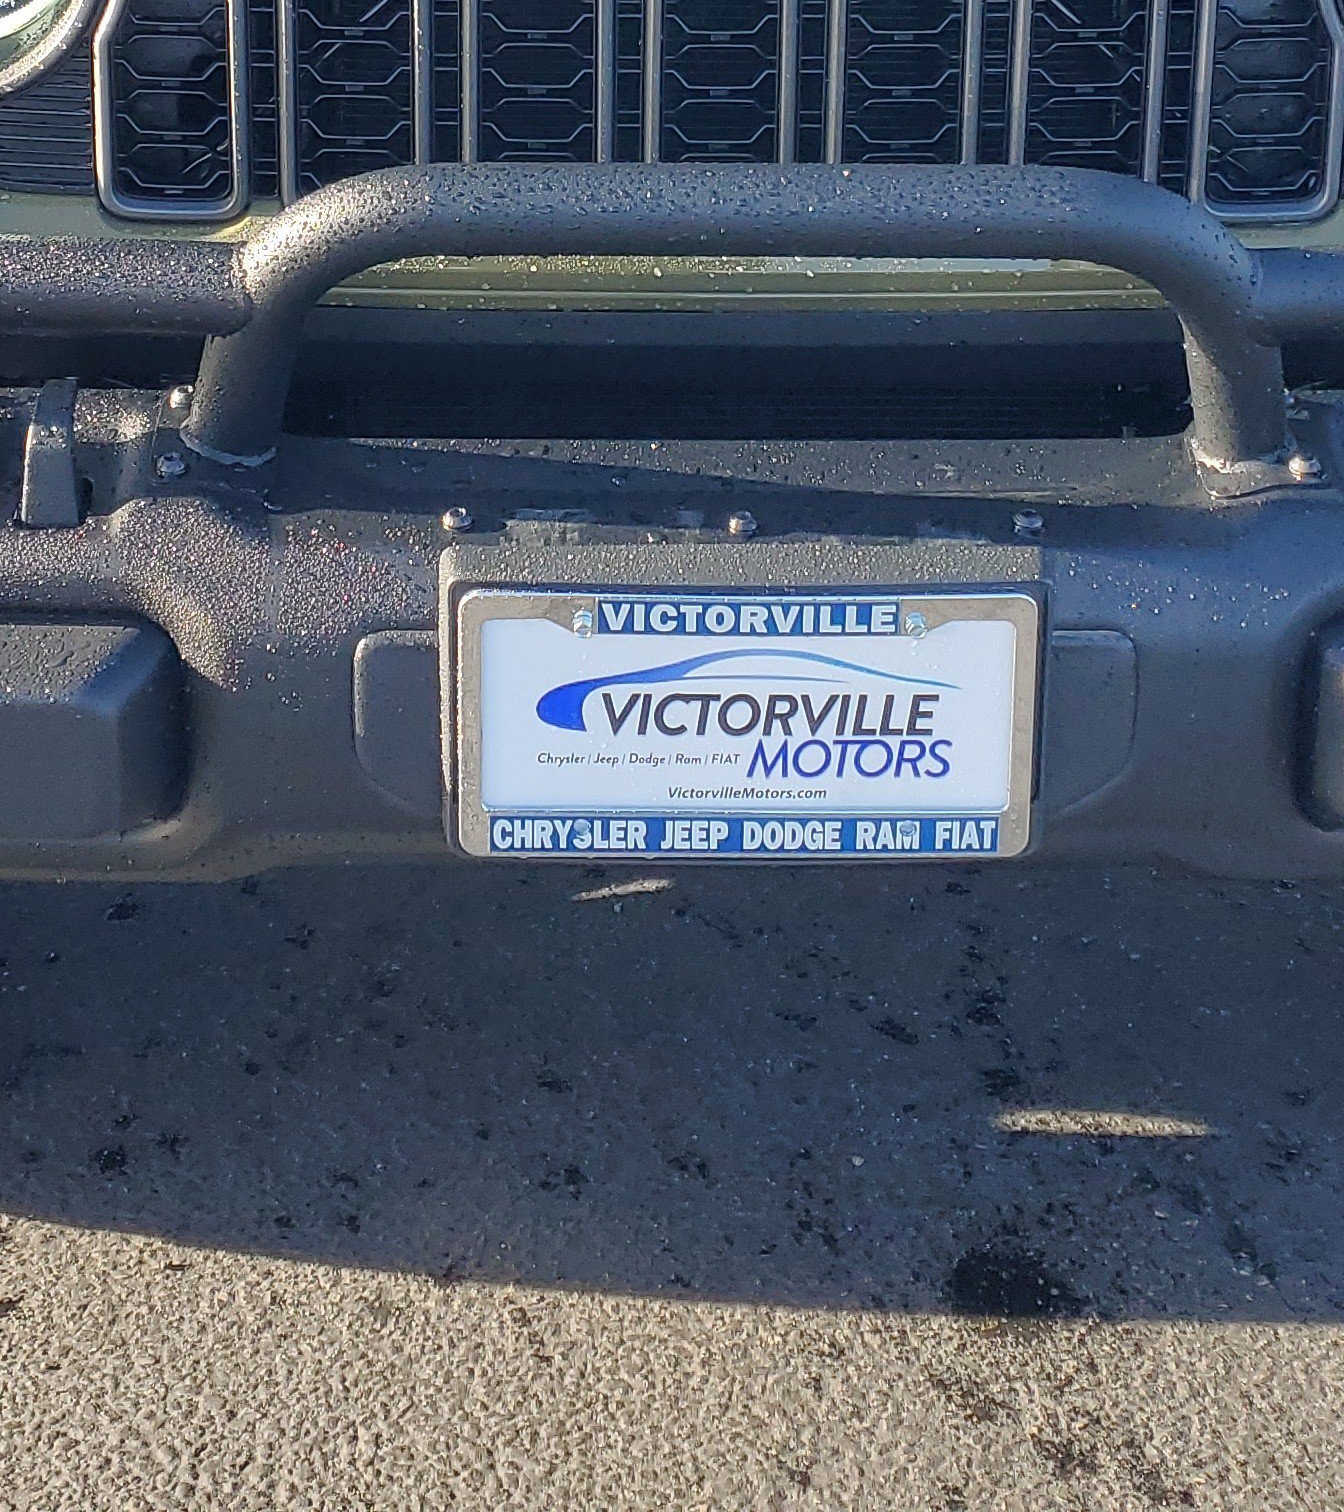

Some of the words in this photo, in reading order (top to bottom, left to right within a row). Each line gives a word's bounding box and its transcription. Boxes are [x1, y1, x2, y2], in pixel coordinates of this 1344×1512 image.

[600, 603, 898, 634] VICTORVILLE
[601, 692, 940, 736] VICTORVILLE
[537, 752, 586, 767] Chrysler
[593, 753, 619, 767] Jeep
[629, 753, 666, 766] Dodge
[675, 754, 702, 765] Ram
[711, 753, 741, 765] FIAT
[746, 738, 953, 778] MOTORS
[668, 786, 827, 800] VictorvilleMotors.com
[493, 819, 647, 850] CHRYSLER
[661, 820, 729, 850] JEEP
[742, 820, 842, 850] DODGE
[856, 821, 920, 850] RAM
[935, 821, 996, 850] FIAT
